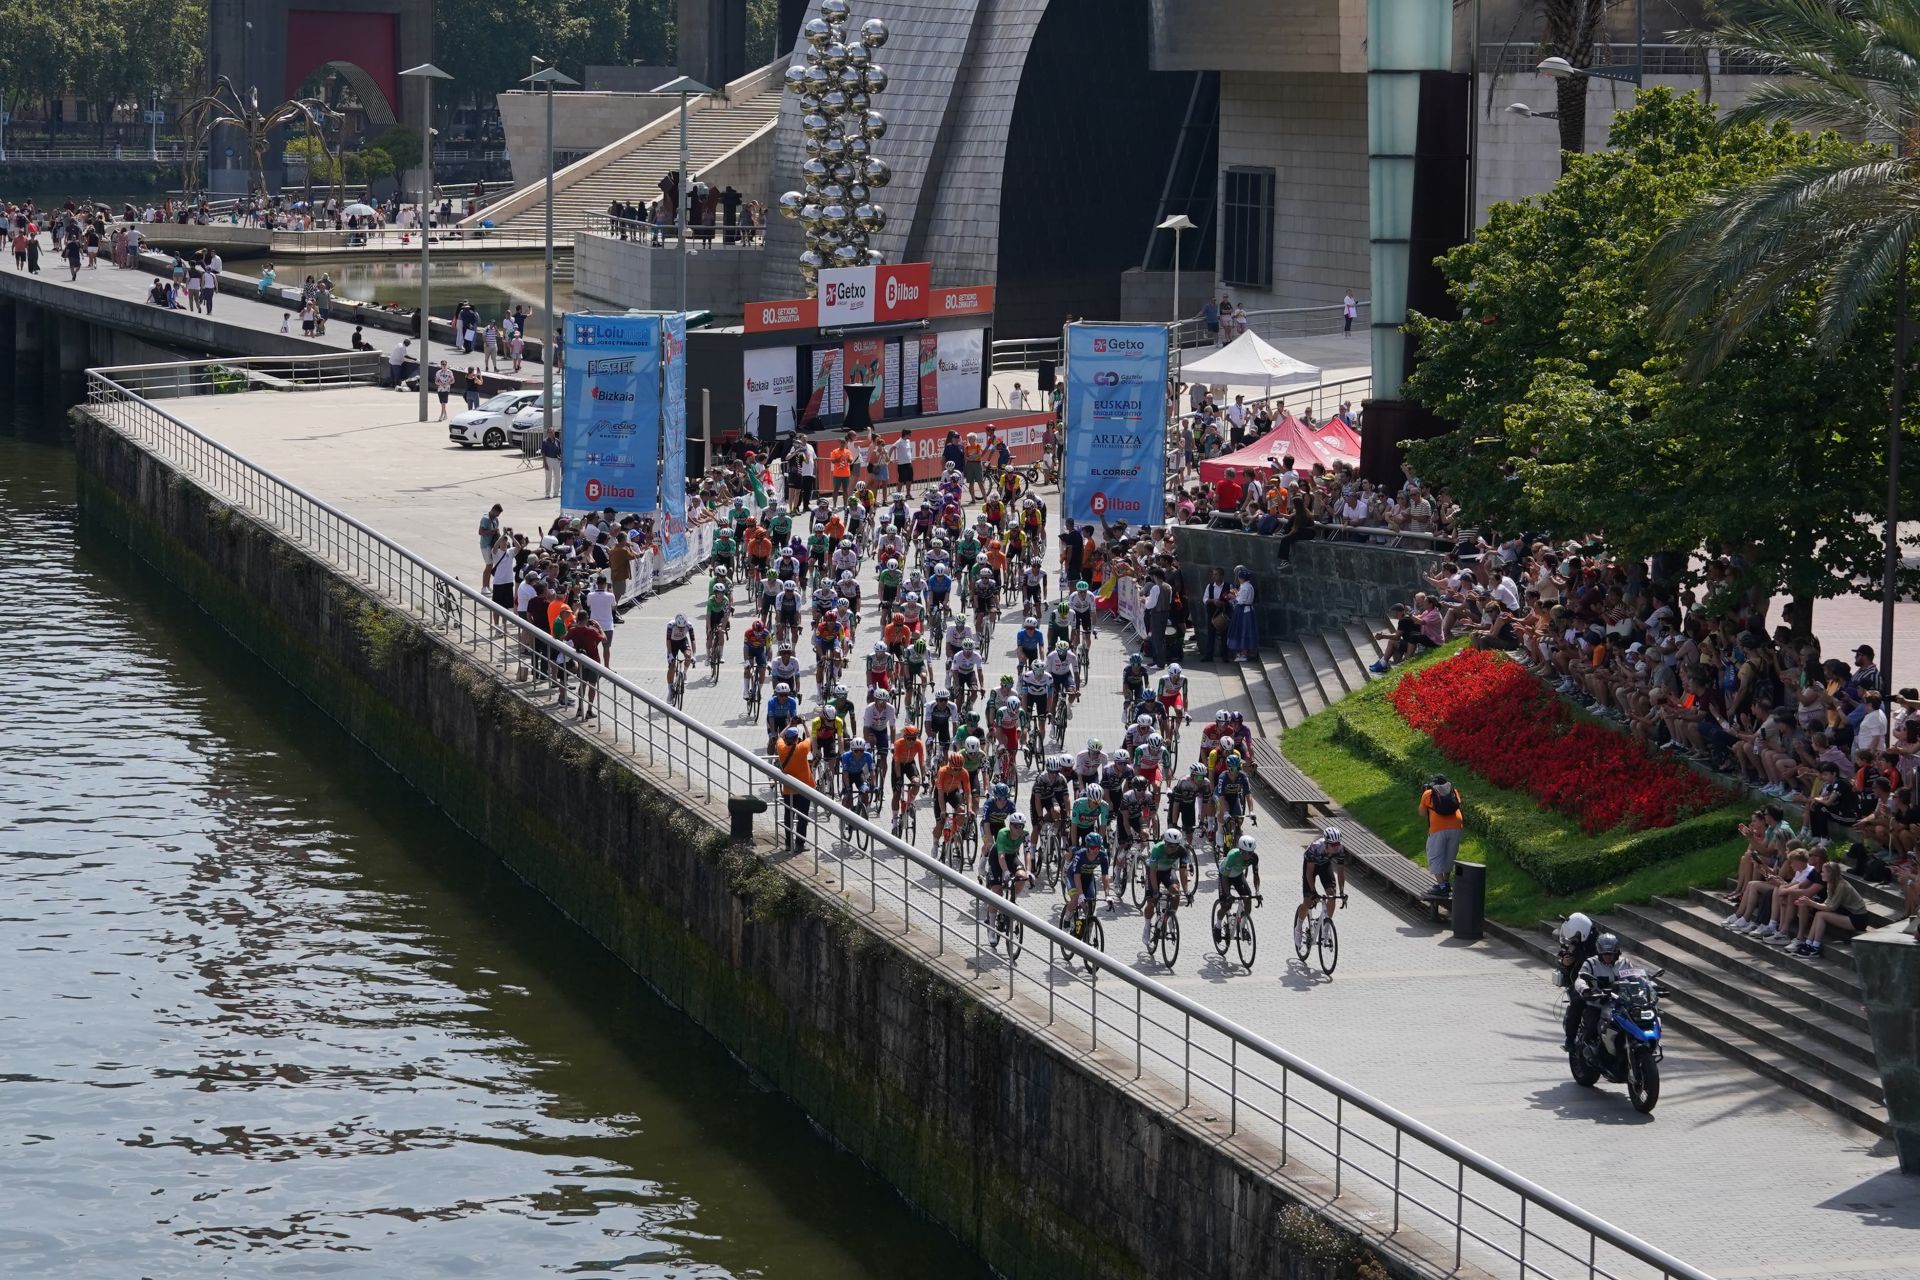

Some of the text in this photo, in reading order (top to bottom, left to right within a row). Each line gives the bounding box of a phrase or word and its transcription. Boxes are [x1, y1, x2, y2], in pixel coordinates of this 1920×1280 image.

[837, 282, 866, 300] Getxo
[945, 294, 958, 309] 80.
[762, 308, 777, 325] 80.
[1108, 338, 1145, 350] Getxo
[750, 379, 769, 392] Bizkaia
[773, 375, 794, 385] EUSKADI
[598, 390, 634, 401] Bizkaia
[1094, 400, 1142, 410] EUSKADI
[1091, 434, 1142, 444] ARTAZA
[1091, 468, 1138, 476] EL CORREO
